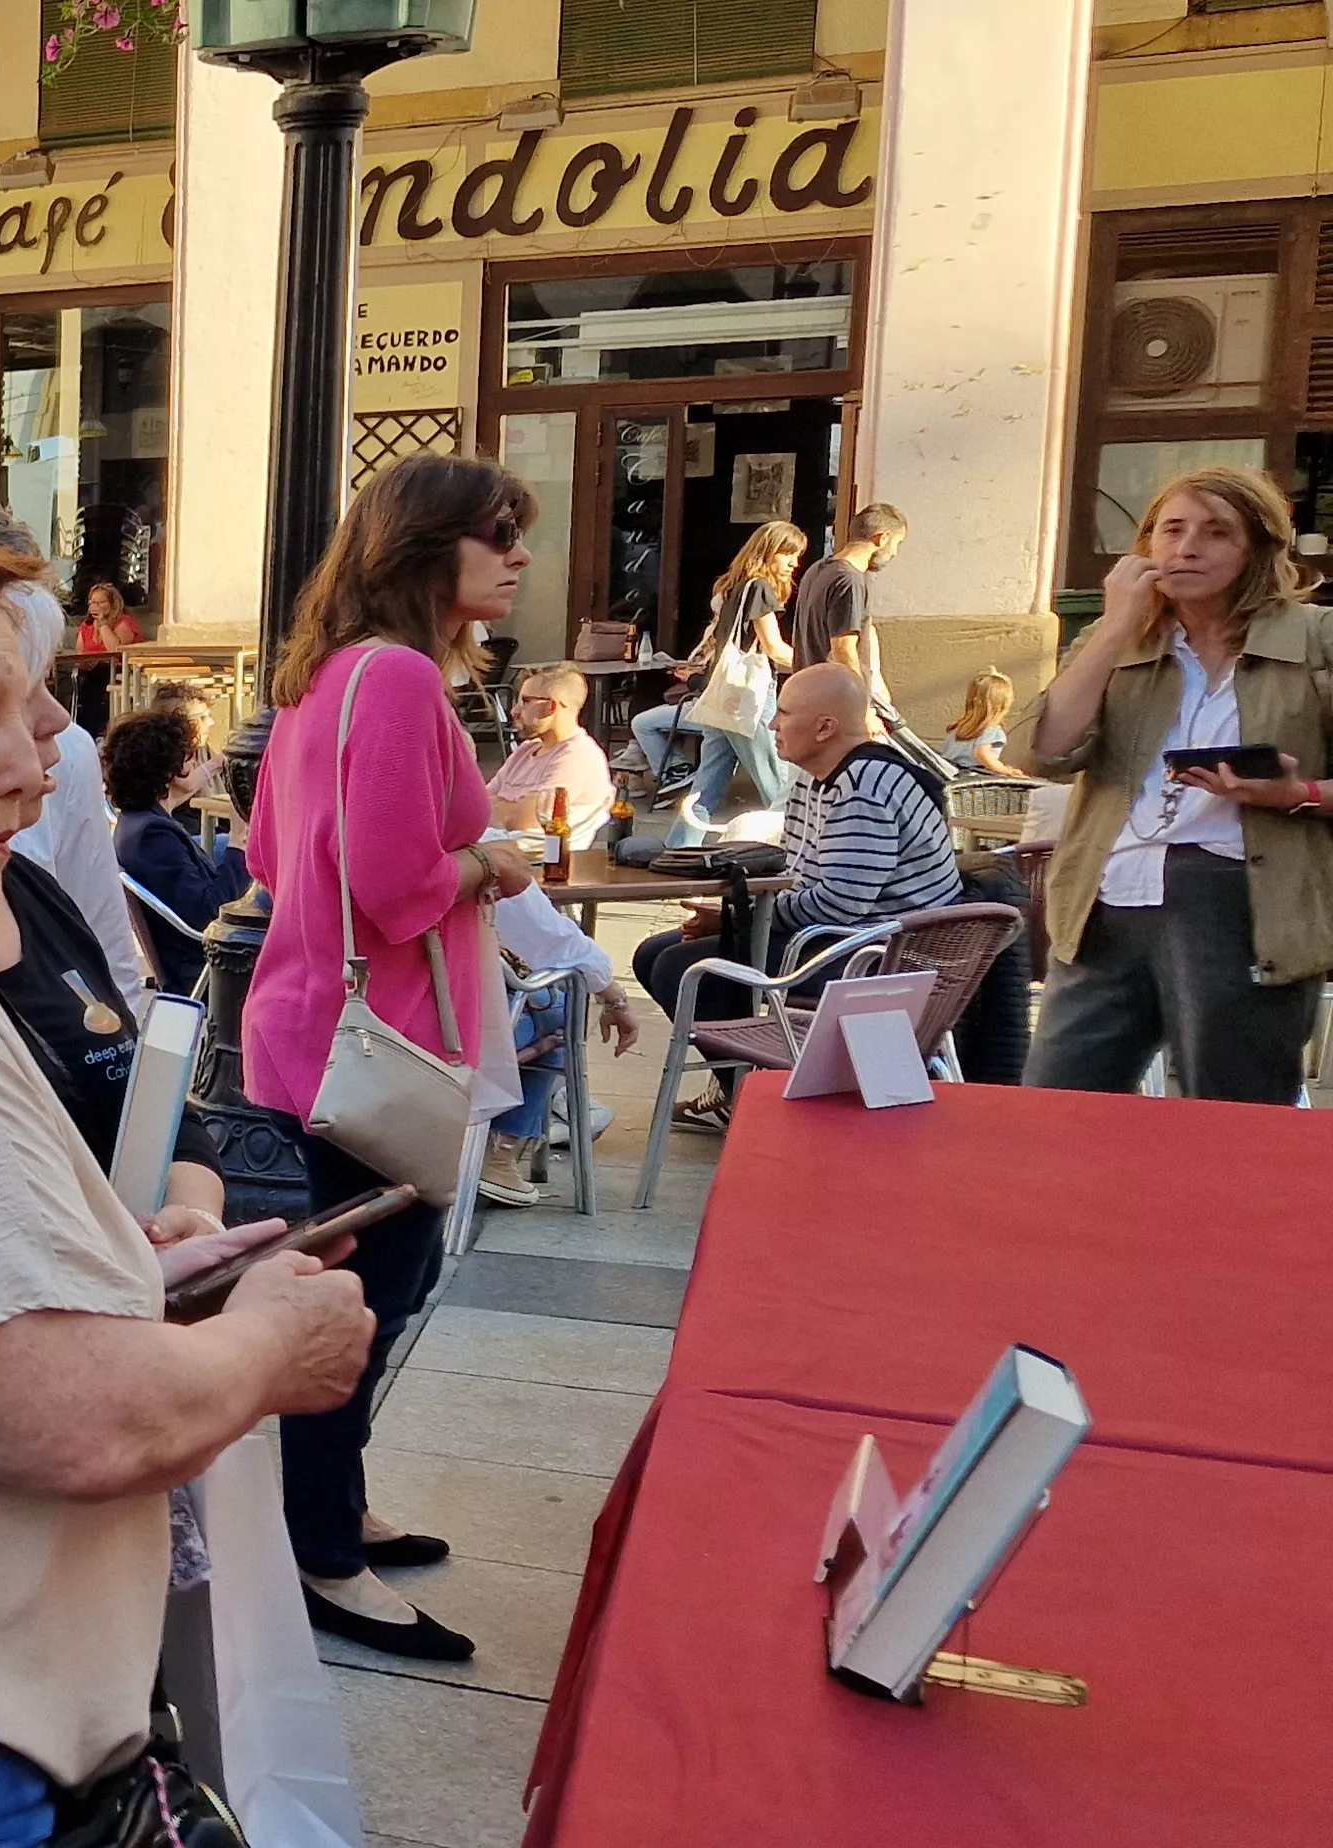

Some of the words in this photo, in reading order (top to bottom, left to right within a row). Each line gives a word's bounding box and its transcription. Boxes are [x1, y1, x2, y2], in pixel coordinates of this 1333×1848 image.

[360, 107, 873, 246] ndolia
[358, 303, 368, 318] E
[355, 329, 459, 351] ECUERDO
[84, 1047, 117, 1064] deep
